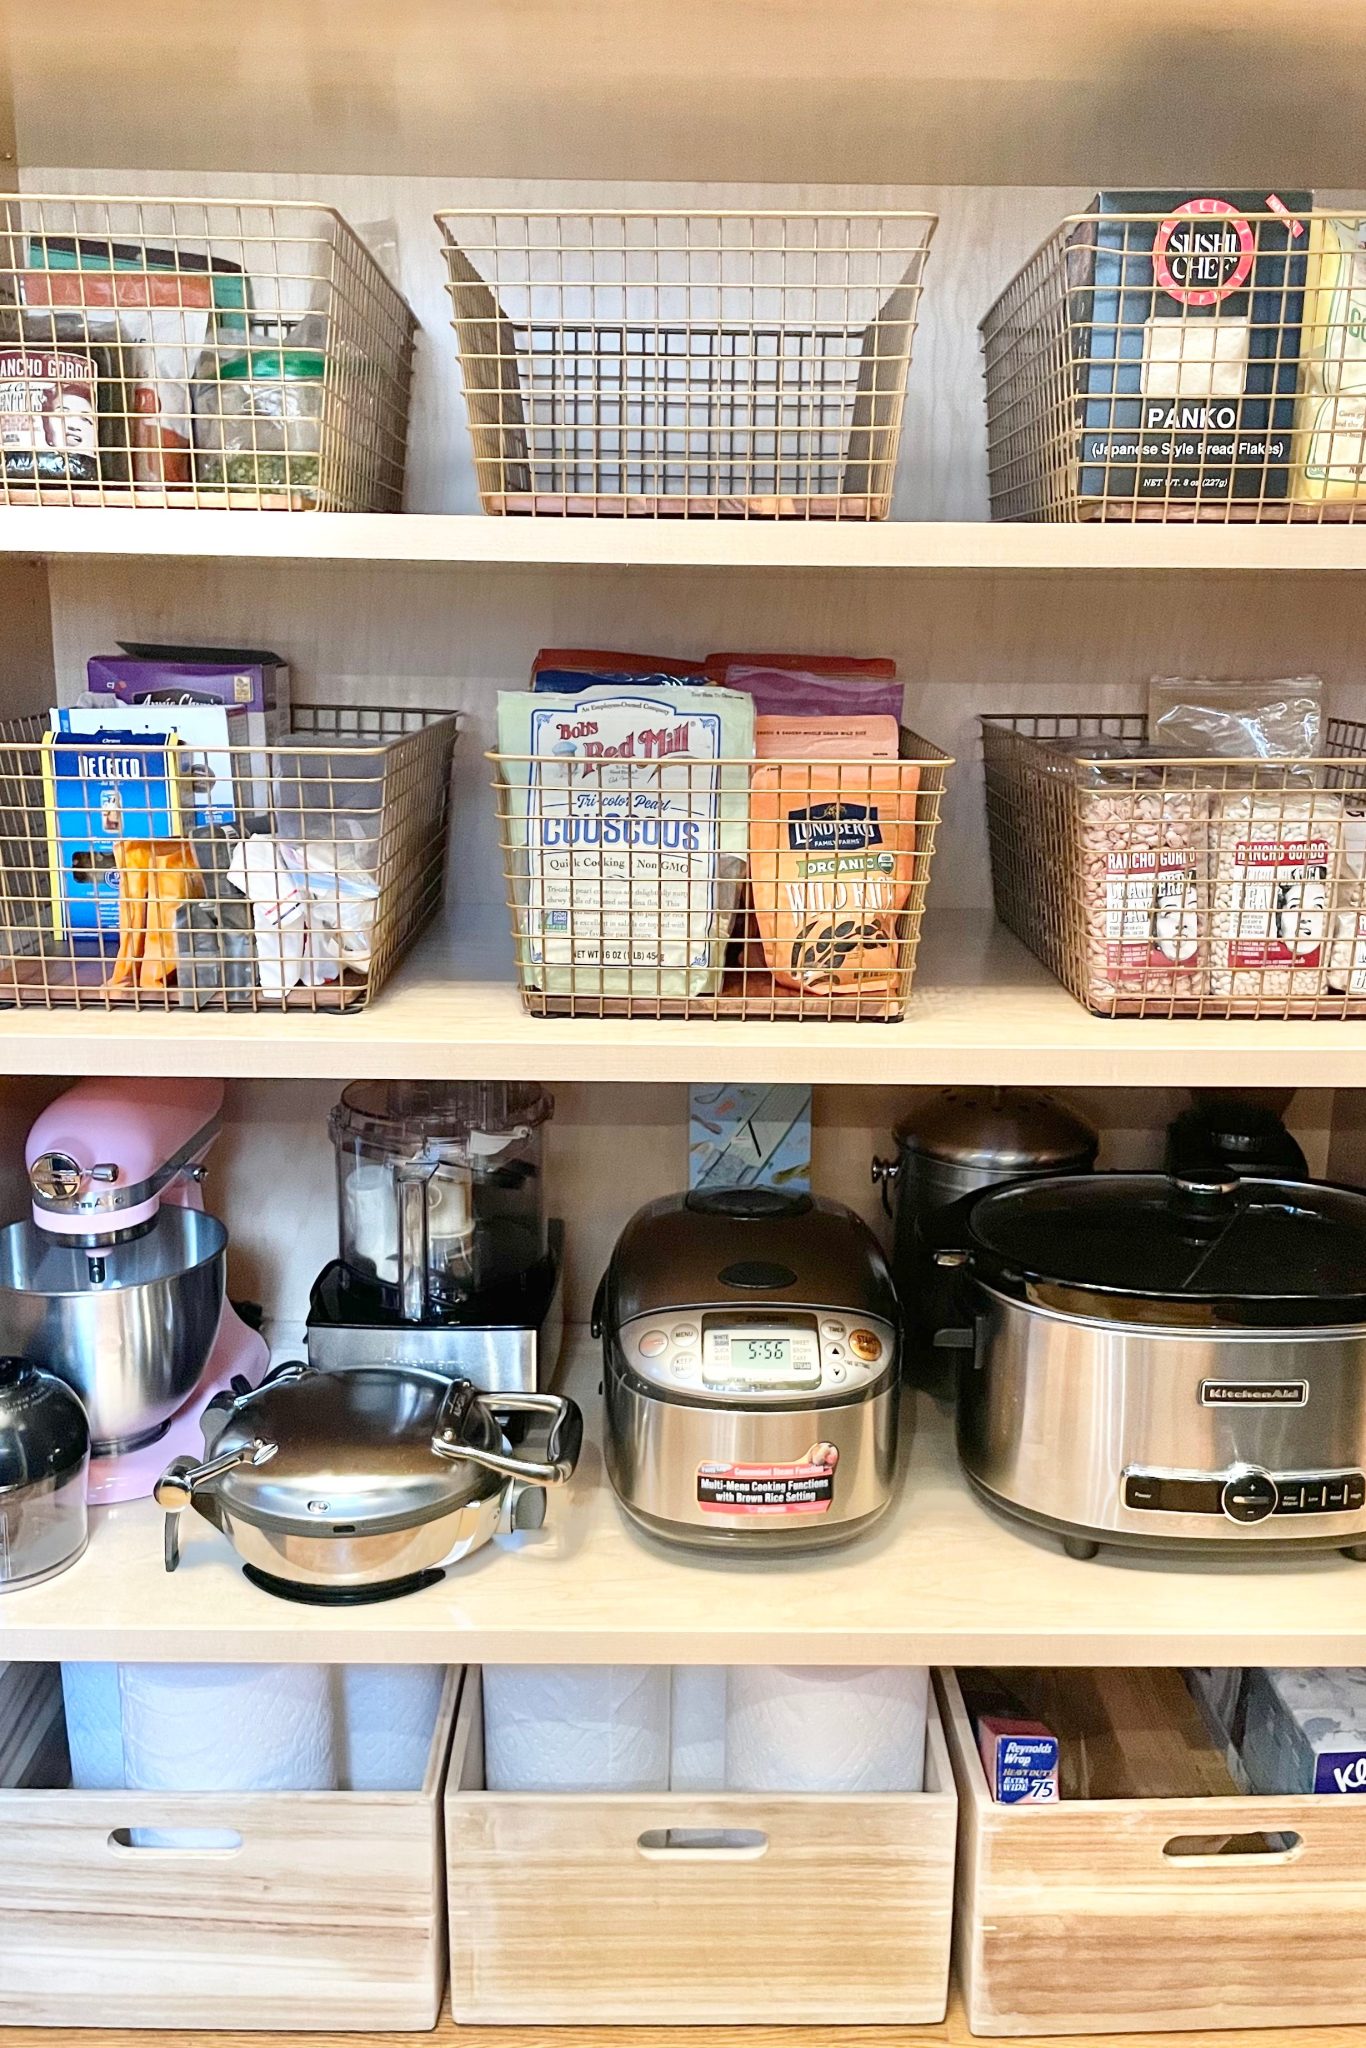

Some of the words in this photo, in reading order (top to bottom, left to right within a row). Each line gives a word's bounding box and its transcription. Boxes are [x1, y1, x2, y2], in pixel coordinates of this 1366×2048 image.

[1169, 233, 1238, 254] SUSHI
[1147, 407, 1236, 429] PANKO
[1092, 442, 1158, 458] (Japanese
[1161, 442, 1194, 457] Syle
[1239, 442, 1284, 458] Flakes)
[1143, 478, 1164, 487] NET
[1202, 478, 1228, 488] (227g)
[556, 720, 600, 741] Bob's
[582, 731, 636, 779] Red
[638, 720, 690, 770] Mill
[542, 812, 701, 851] COUSCOUS
[794, 818, 876, 846] LUNDBERG
[550, 858, 581, 871] Quik
[583, 856, 626, 874] Coking
[807, 857, 875, 875] ORGANIC
[1107, 853, 1156, 870] RANCHO
[785, 879, 848, 928] WILD
[572, 950, 585, 959] ET
[588, 950, 599, 959] WT
[601, 951, 611, 960] 6
[612, 951, 622, 960] OZ
[633, 951, 645, 961] LB)
[748, 1341, 783, 1360] 5:56
[1209, 1388, 1299, 1399] KitchenAid
[701, 1477, 750, 1492] Multi-Menu
[751, 1480, 787, 1493] Cooking
[787, 1477, 829, 1491] Functions
[715, 1491, 735, 1502] with
[736, 1492, 763, 1503] Brown
[764, 1492, 784, 1503] Rice
[785, 1490, 816, 1502] Setting
[1006, 1741, 1053, 1756] Reynolds
[1003, 1753, 1032, 1767] Wrap
[1002, 1768, 1028, 1777] HEAVY
[1003, 1776, 1029, 1784] EXTRA
[1002, 1783, 1028, 1792] WIDE
[1032, 1780, 1054, 1798] 75
